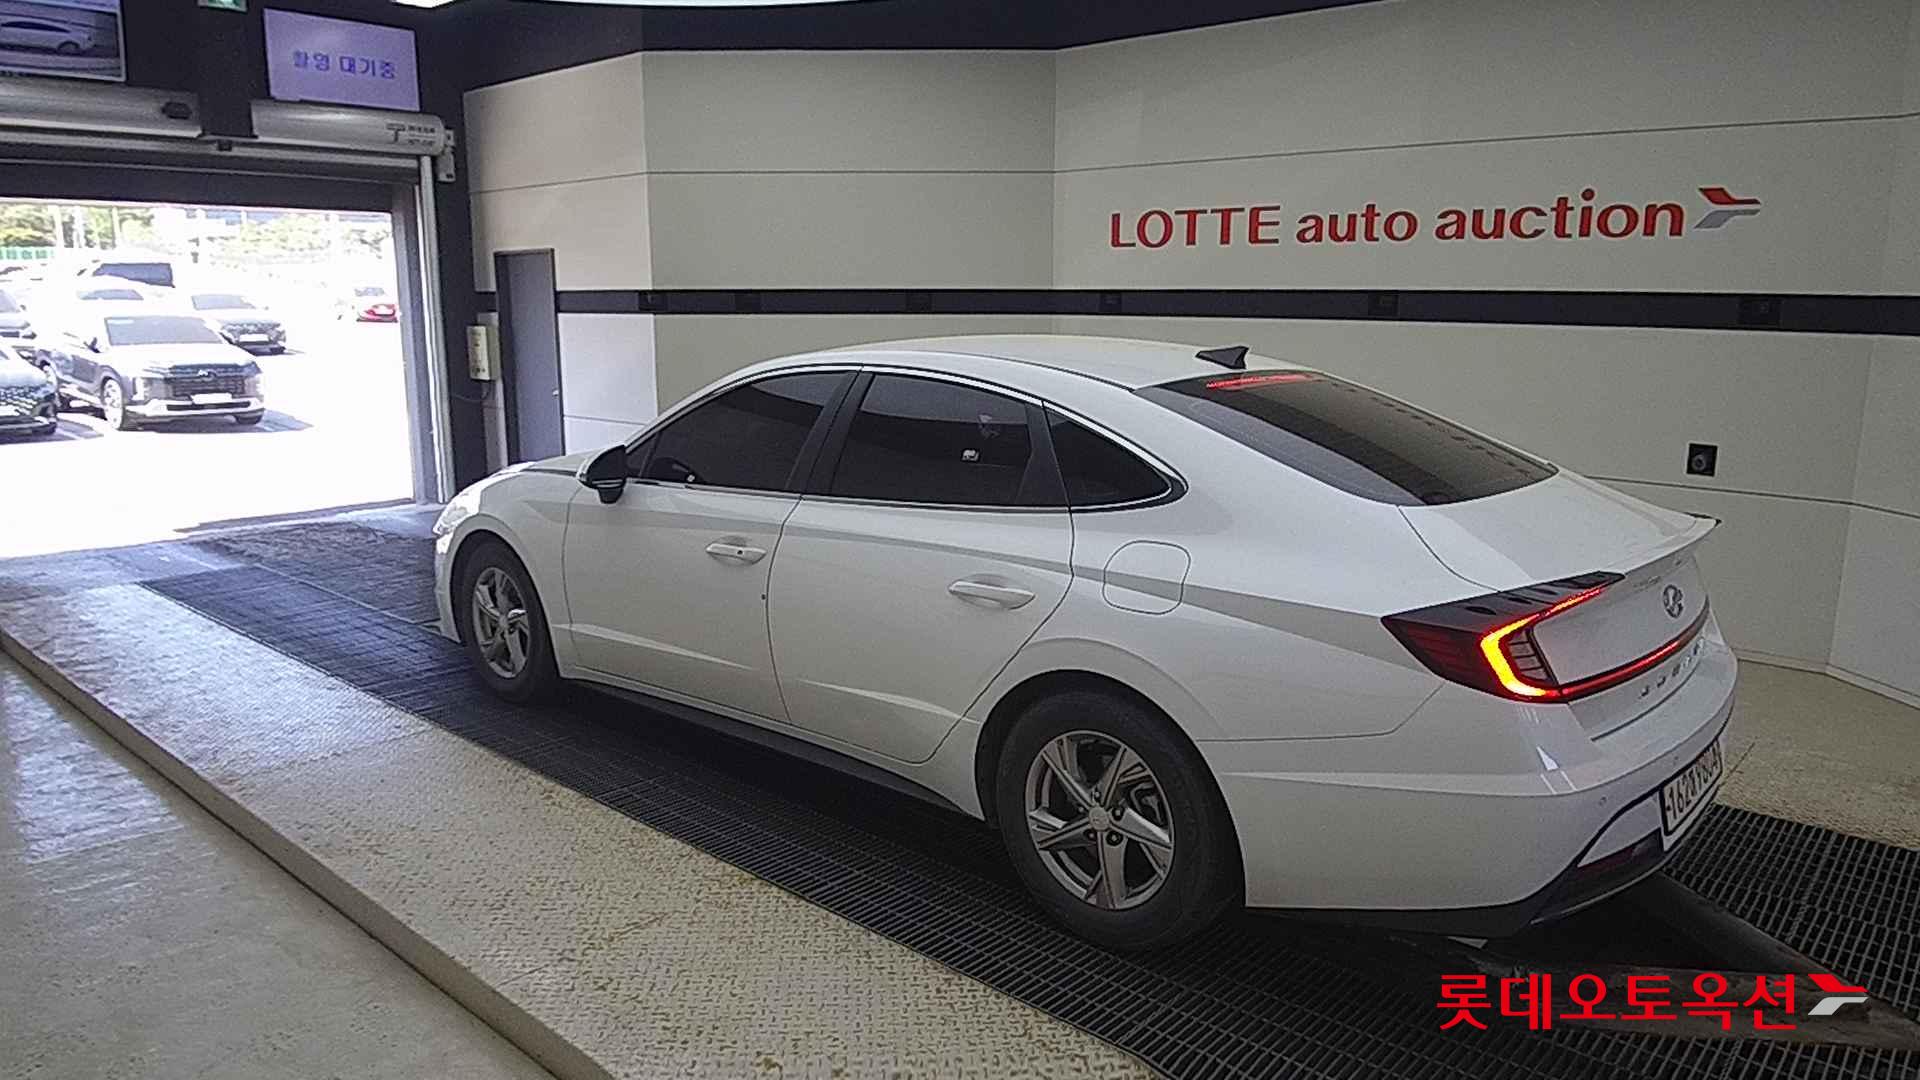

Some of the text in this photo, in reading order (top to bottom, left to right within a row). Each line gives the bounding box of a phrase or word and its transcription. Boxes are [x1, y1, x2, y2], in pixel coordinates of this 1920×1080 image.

[339, 56, 396, 79] 대기중
[1111, 188, 1684, 248] LOTTE auto auction
